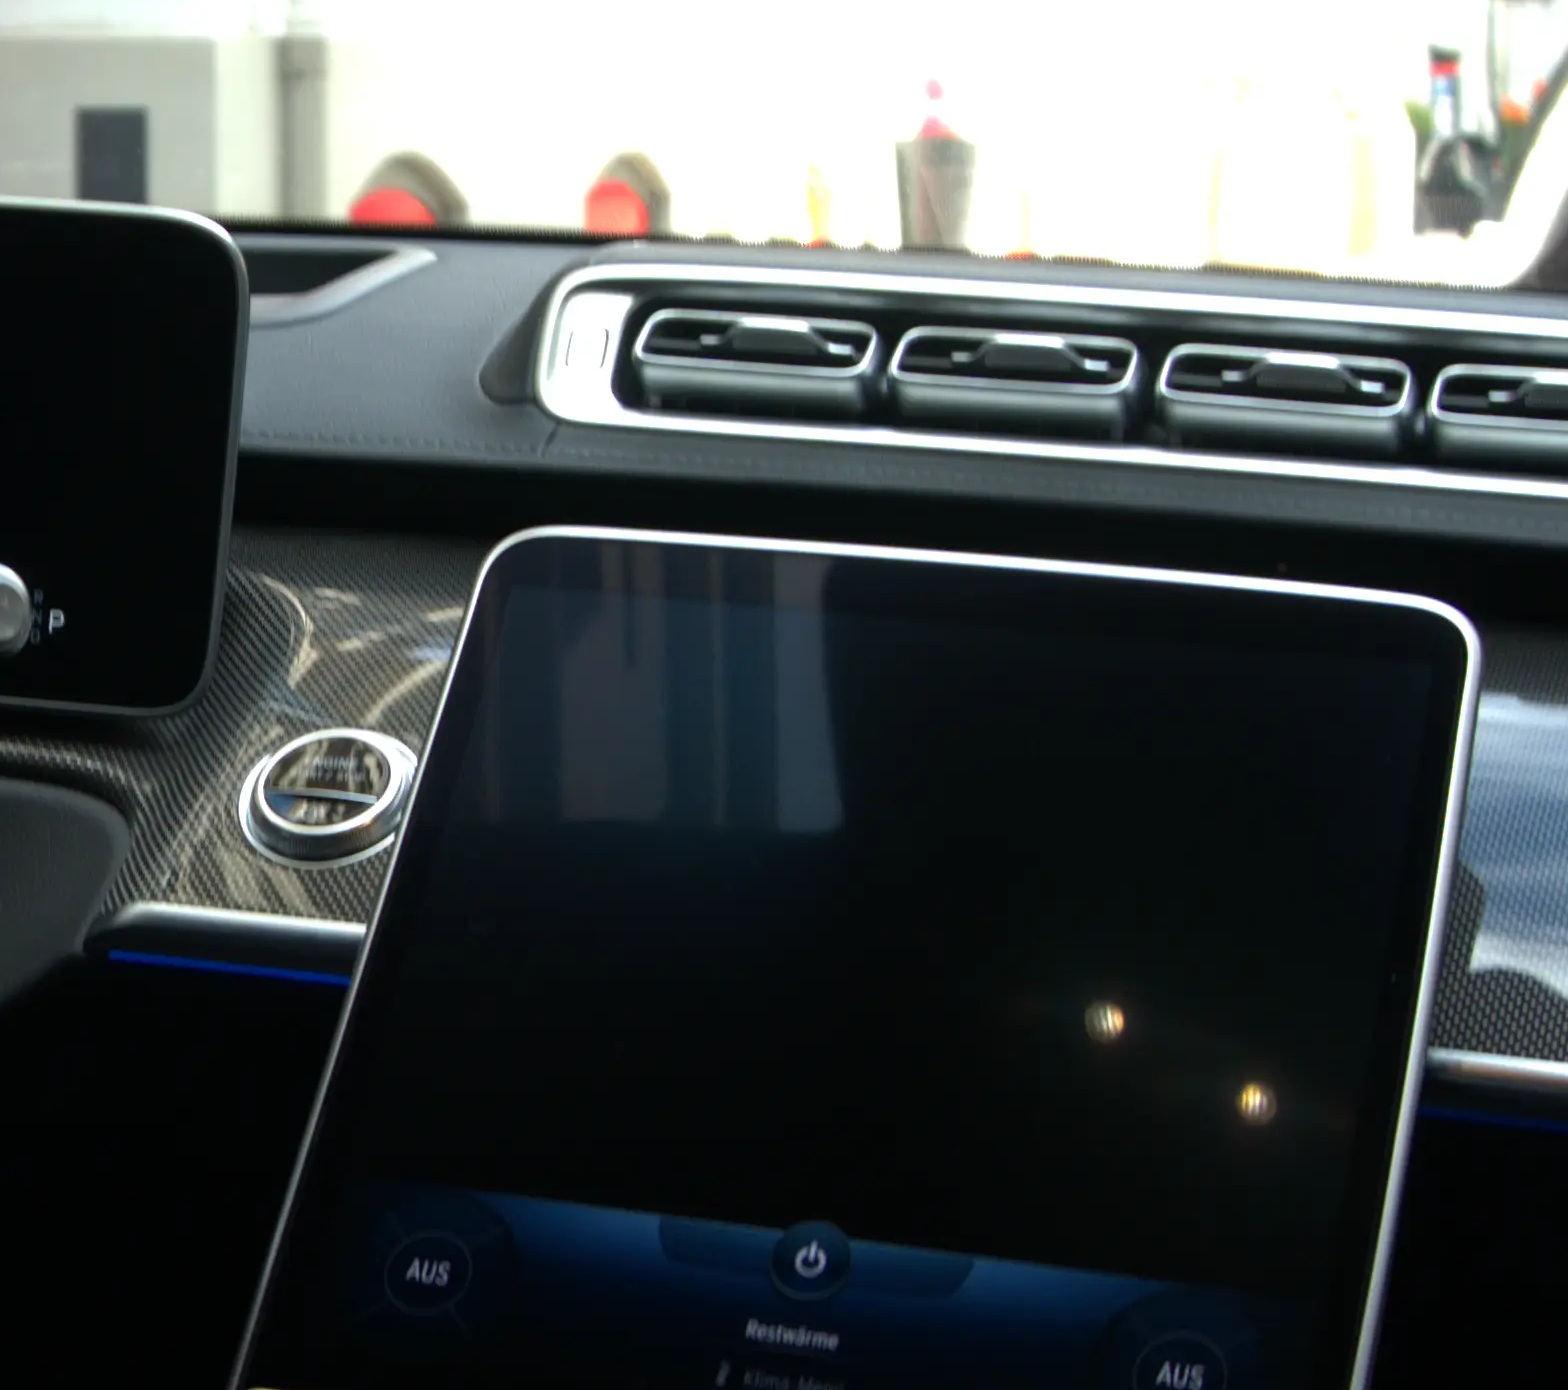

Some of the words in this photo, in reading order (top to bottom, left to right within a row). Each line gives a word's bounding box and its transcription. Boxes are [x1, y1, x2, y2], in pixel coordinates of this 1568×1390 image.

[49, 606, 66, 636] P
[405, 1255, 453, 1288] AUS
[744, 1317, 841, 1352] Restwärme
